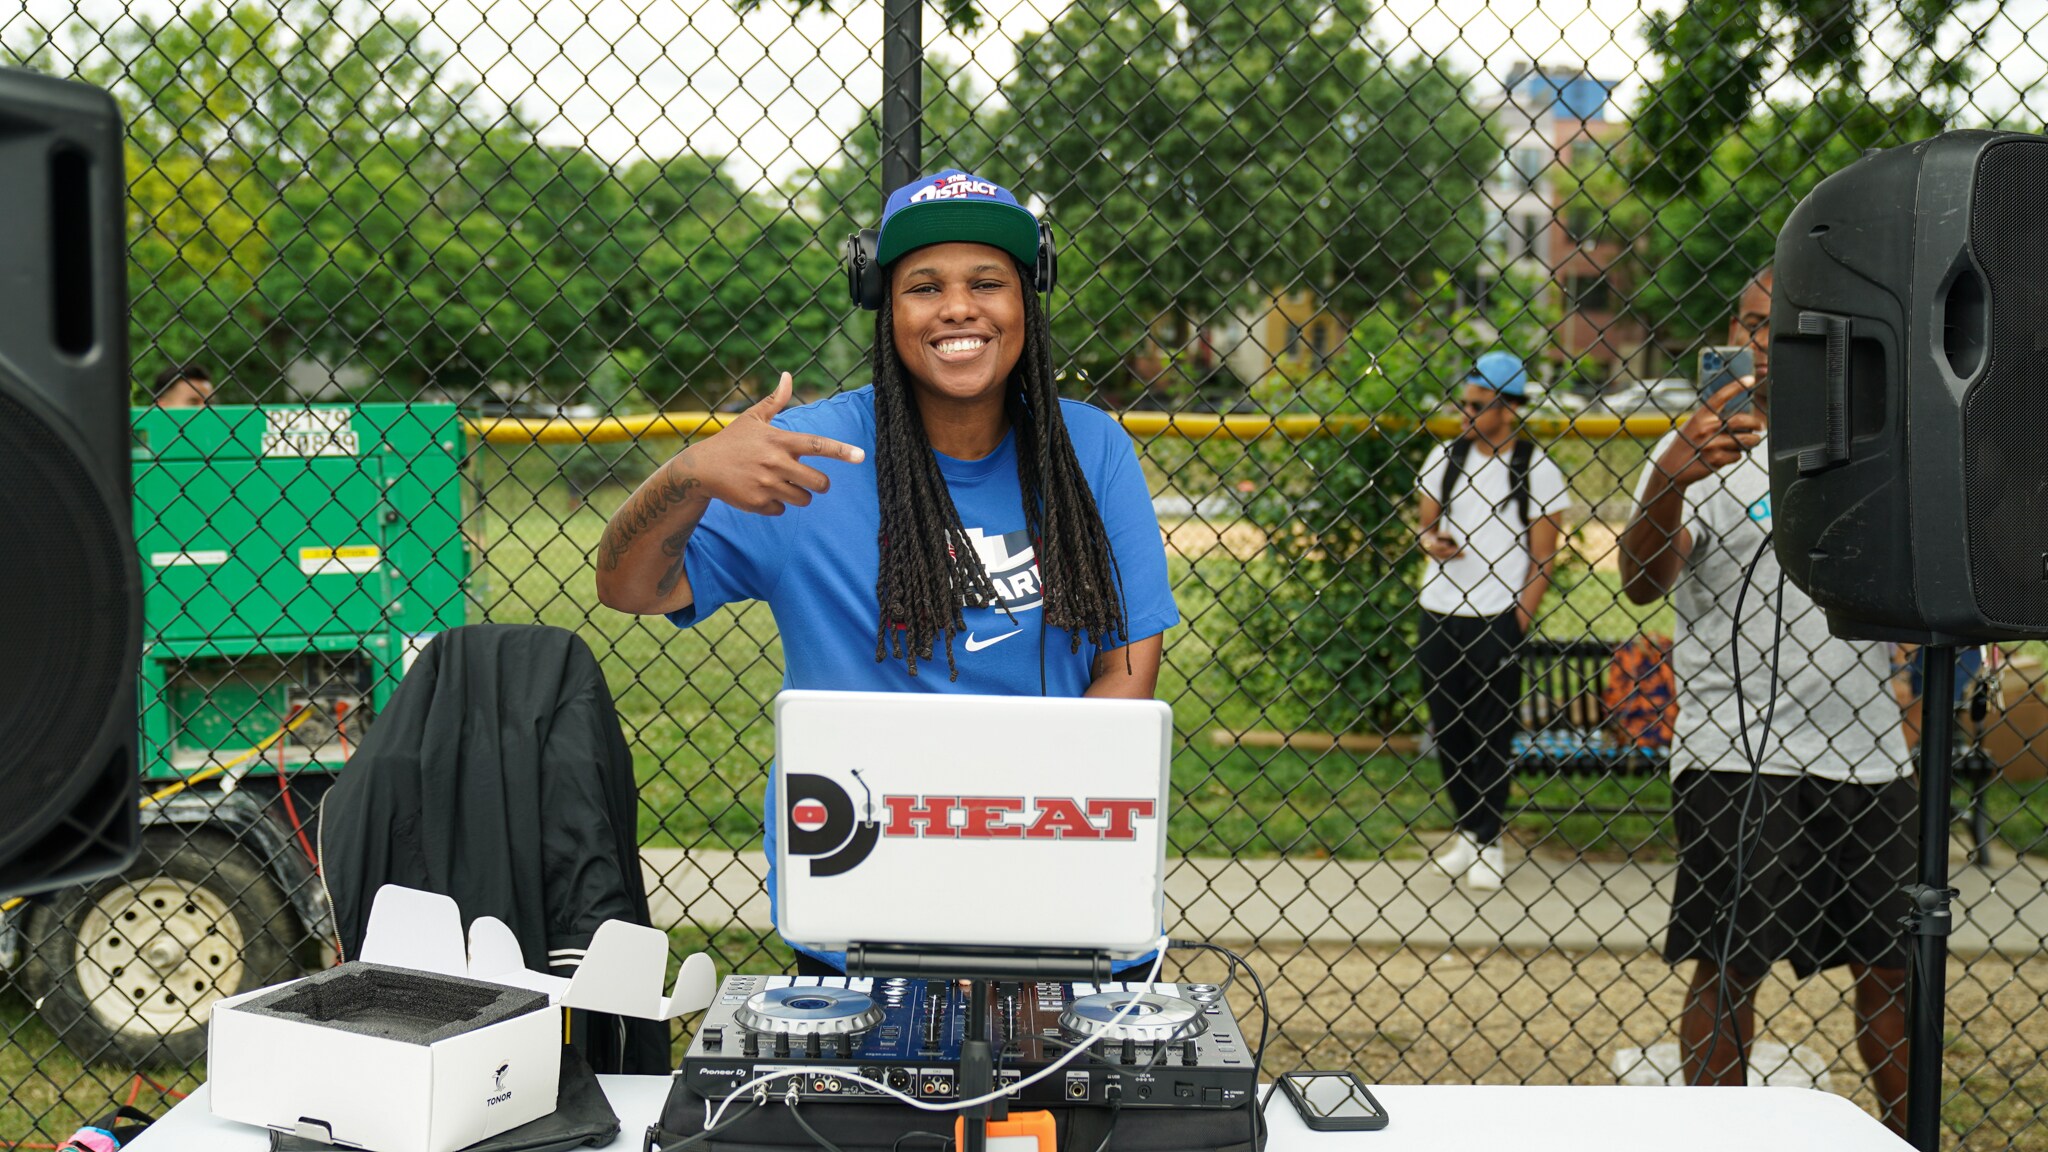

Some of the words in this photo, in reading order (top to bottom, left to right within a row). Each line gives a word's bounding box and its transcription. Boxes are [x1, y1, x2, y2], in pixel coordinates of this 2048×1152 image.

[946, 174, 968, 184] THE
[909, 180, 998, 203] DISTRICT
[271, 410, 348, 430] PC179
[883, 794, 1156, 841] HEAT
[699, 1067, 735, 1076] Pioneer
[486, 1091, 512, 1107] TONOR
